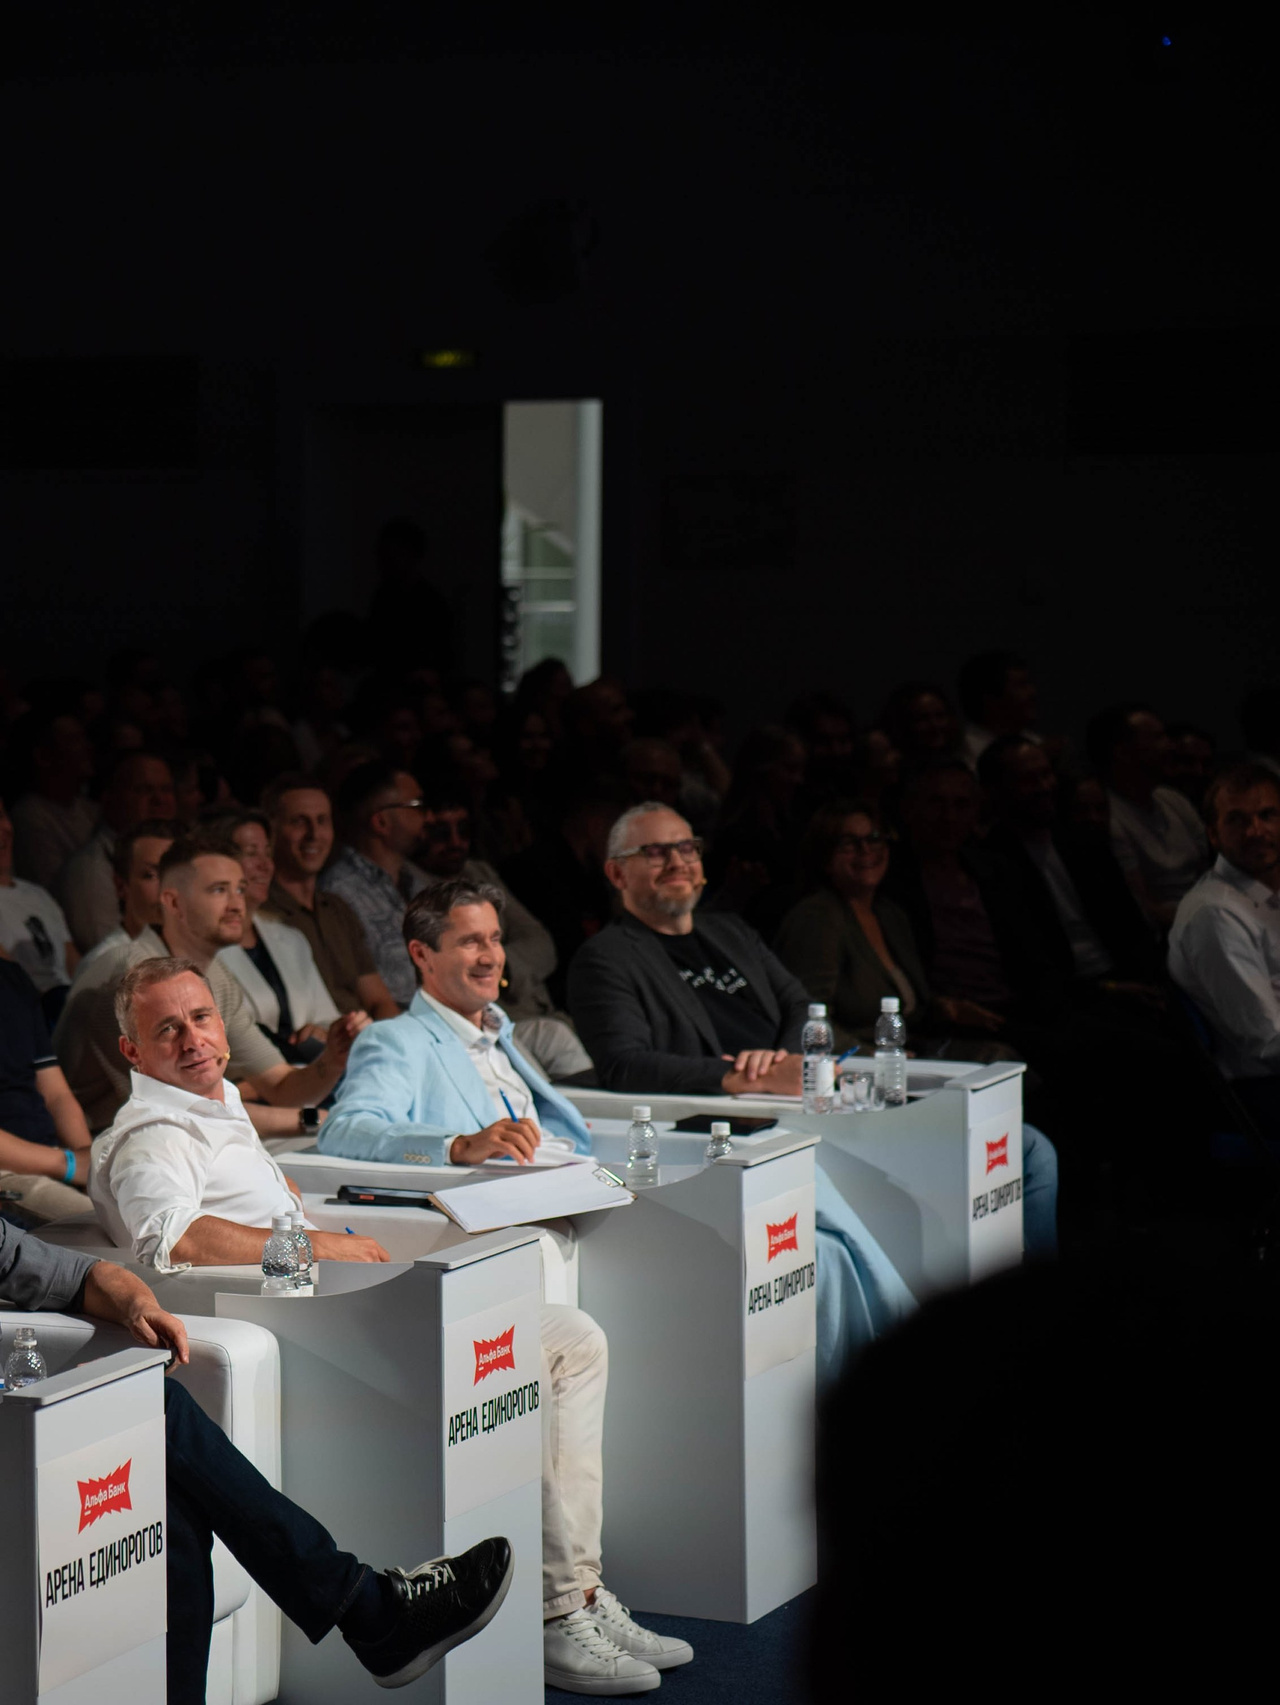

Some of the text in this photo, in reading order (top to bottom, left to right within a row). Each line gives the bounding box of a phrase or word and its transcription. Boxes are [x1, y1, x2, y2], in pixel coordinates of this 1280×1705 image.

[748, 1262, 815, 1315] АРЕНА ЕДИНОРОГОВ
[478, 1344, 511, 1366] Альфа Банк
[448, 1380, 540, 1447] АРЕНА ЕДИНОРОГОВ
[84, 1481, 126, 1510] Альфа Банк
[46, 1521, 163, 1609] АРЕНА ЕДИНОРОГОВ
